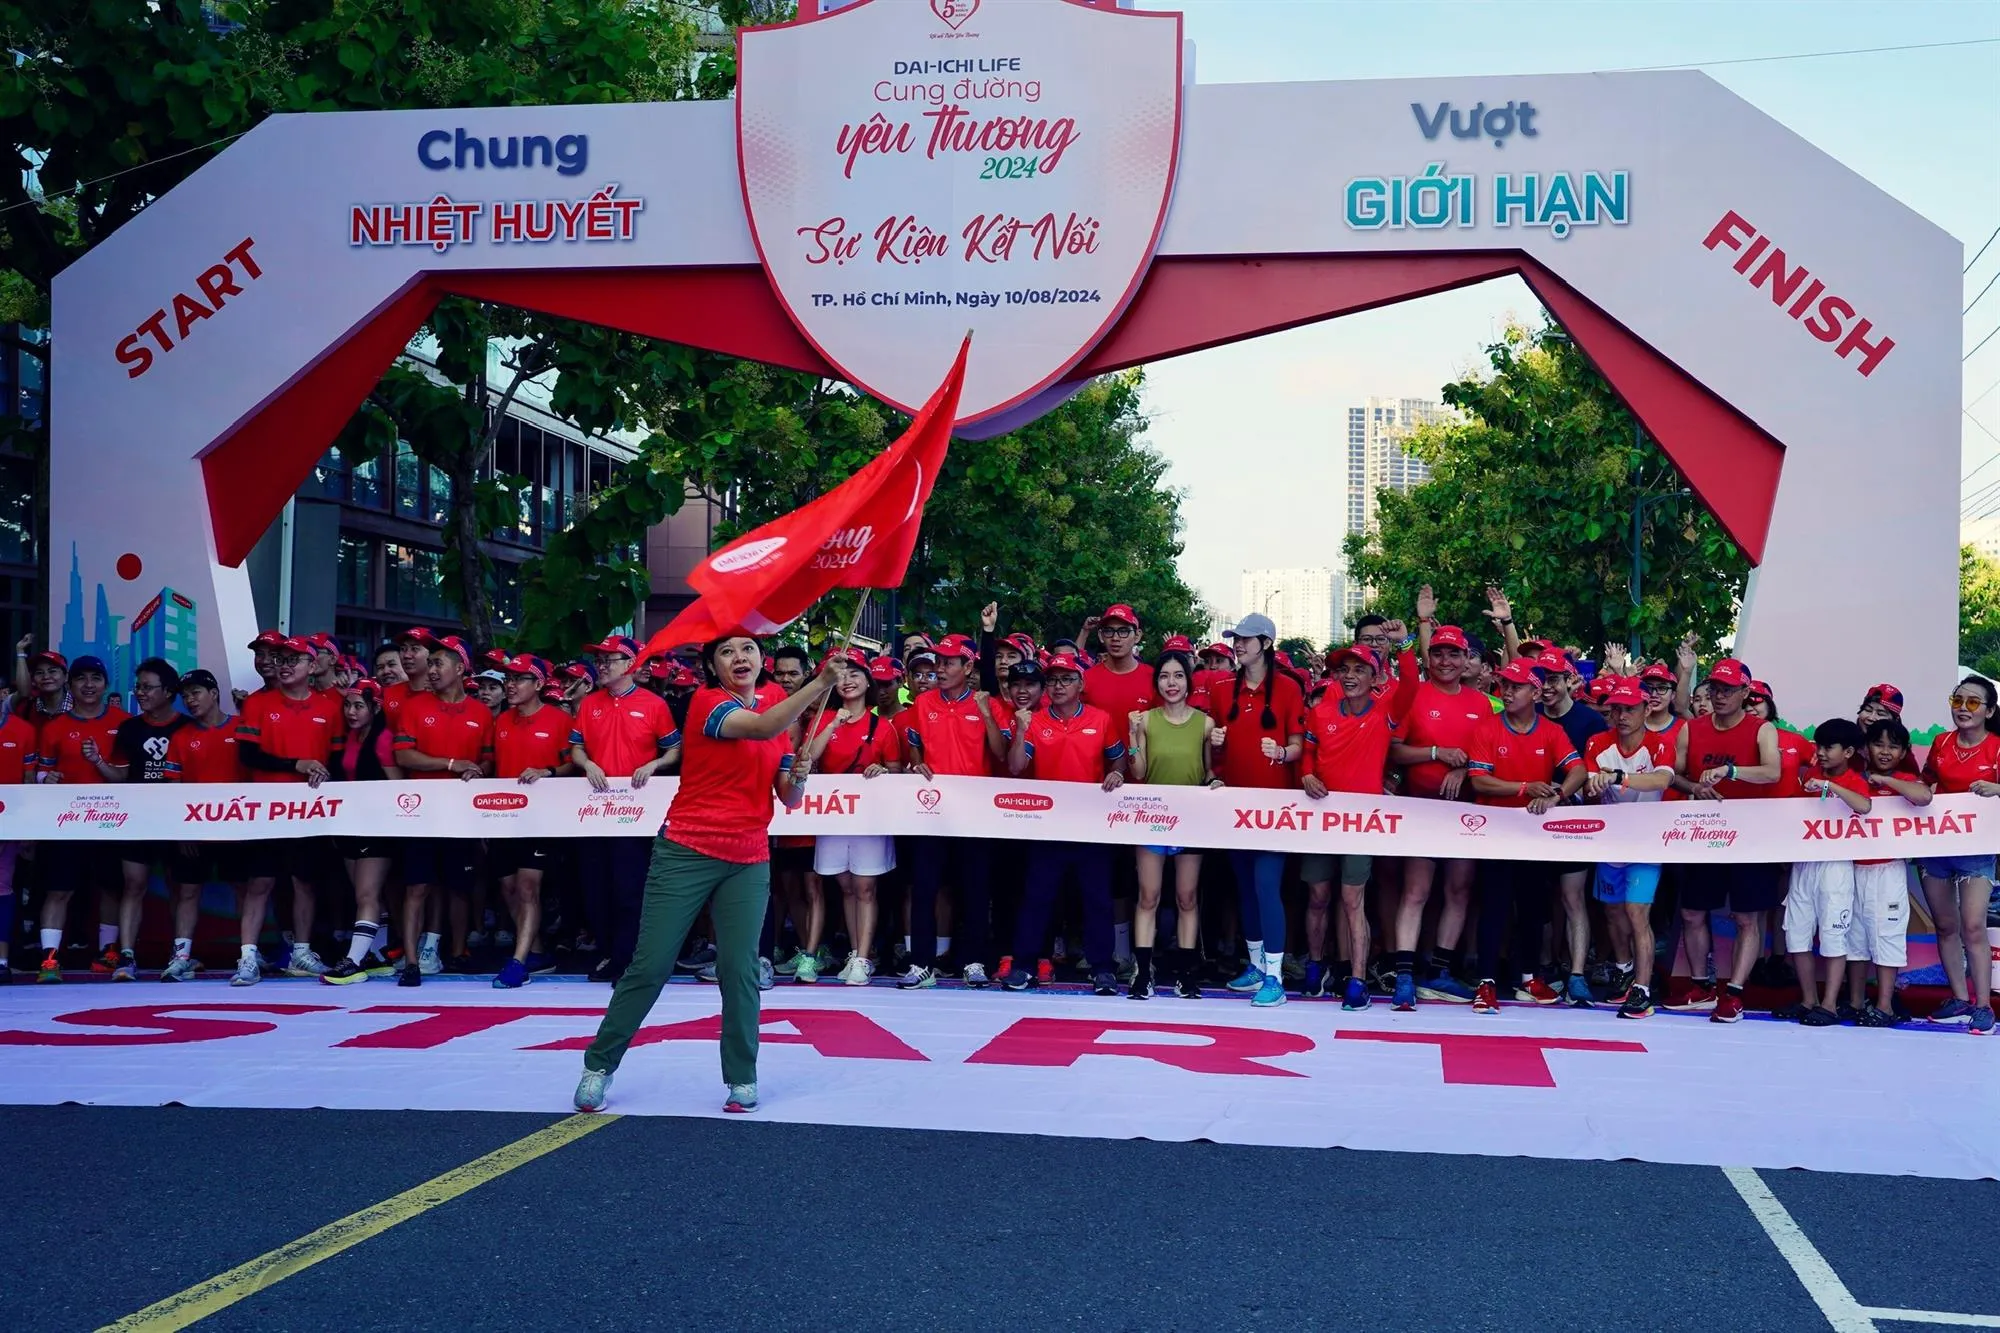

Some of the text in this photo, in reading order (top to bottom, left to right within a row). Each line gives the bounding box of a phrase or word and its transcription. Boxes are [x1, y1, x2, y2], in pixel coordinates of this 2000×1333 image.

[894, 57, 1021, 75] DAI-ICHI LIFE
[874, 76, 1041, 105] Cung đường
[1411, 101, 1538, 148] Vượt
[417, 128, 589, 175] Chung
[836, 111, 916, 179] yêu
[979, 156, 1039, 180] 2024
[1344, 161, 1629, 240] GIỚI HẠN
[350, 184, 643, 252] NHIỆT HUYẾT
[797, 212, 1101, 266] Sự Kiện Kết Nối
[114, 237, 264, 378] START
[812, 289, 1101, 308] TP. Hồ Chí Minh, Ngày 10/08/2024
[1702, 210, 1896, 377] FINISH
[811, 554, 847, 569] 2024
[57, 811, 80, 827] yêu
[184, 796, 343, 822] XUẤT PHÁT
[577, 804, 600, 823] yêu
[1107, 810, 1131, 828] yêu
[1233, 802, 1403, 834] XUẤT PHÁT
[1803, 809, 1977, 840] XUẤT PHÁT
[1662, 828, 1687, 846] yêu
[0, 1003, 1649, 1088] START
